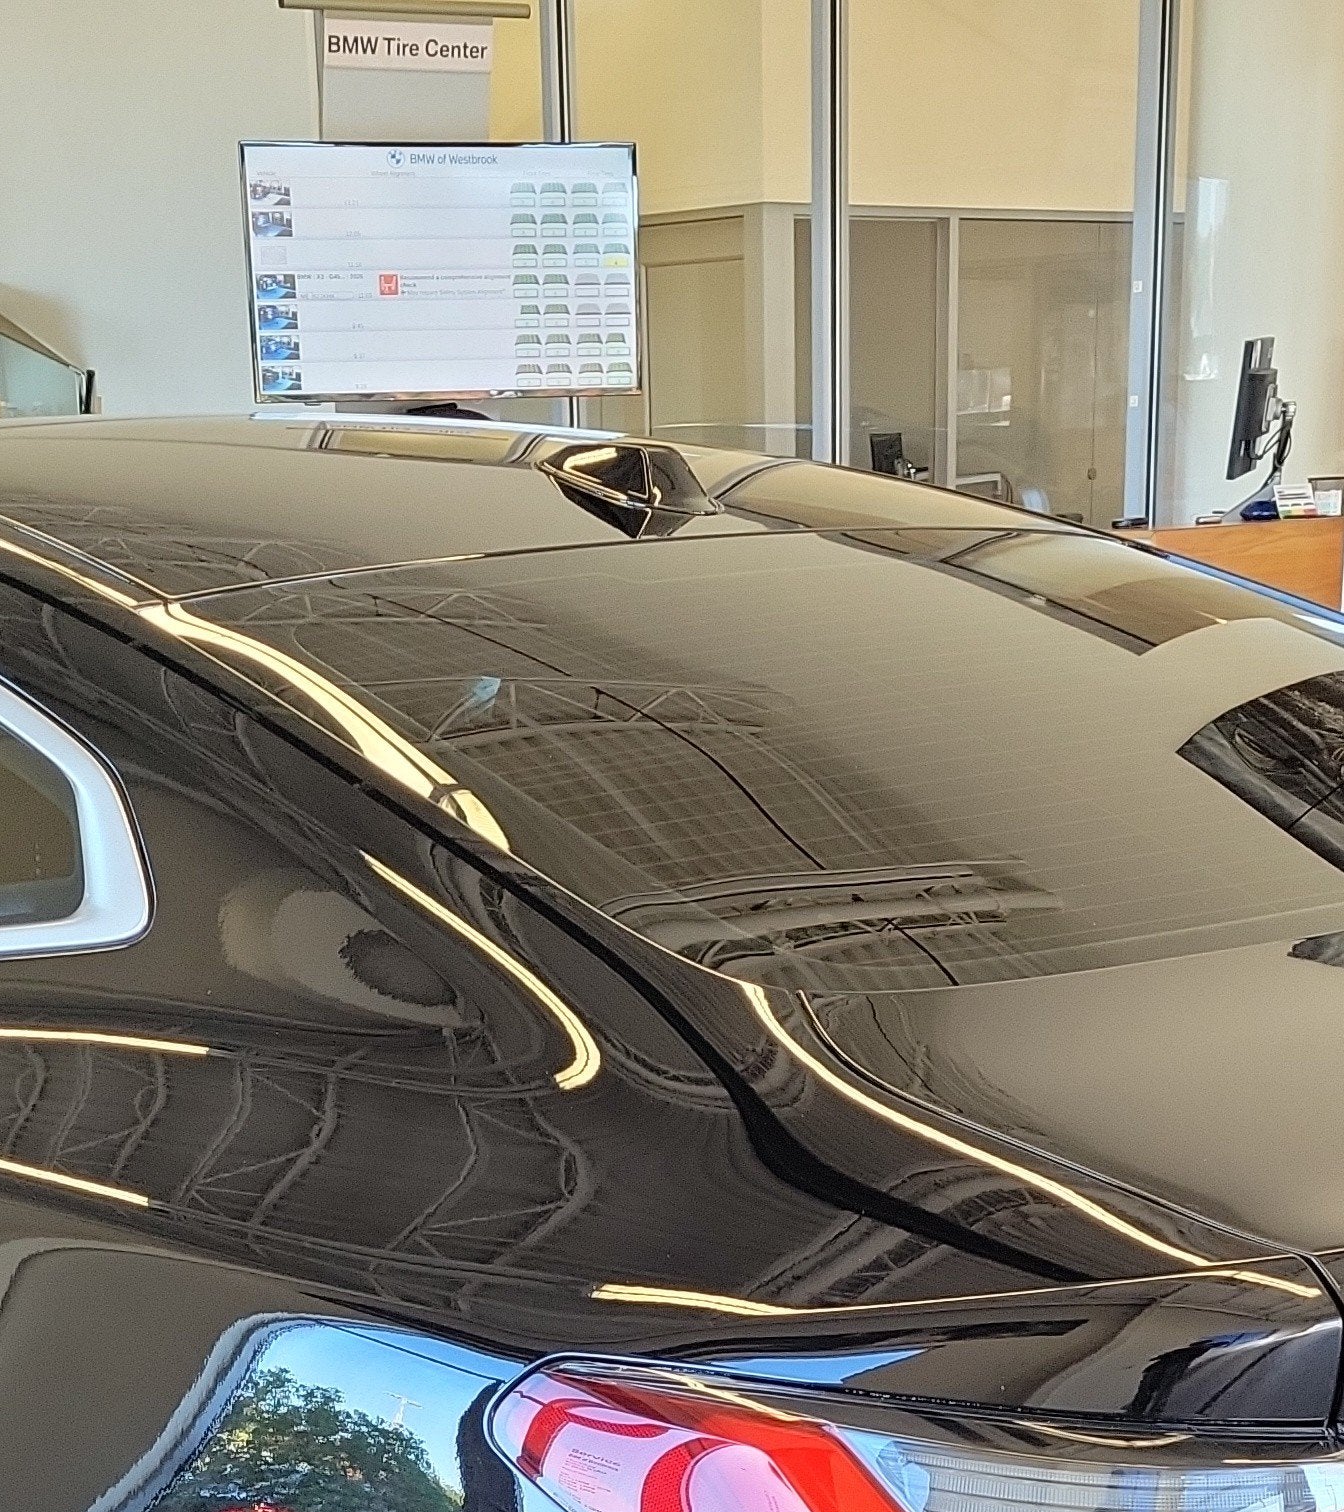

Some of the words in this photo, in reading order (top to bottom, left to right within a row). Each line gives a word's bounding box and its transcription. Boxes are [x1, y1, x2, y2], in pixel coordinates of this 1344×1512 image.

[328, 35, 378, 55] BMW
[383, 37, 419, 57] Tire
[425, 39, 488, 59] Center
[409, 153, 435, 165] BMW
[437, 153, 447, 165] of
[449, 154, 498, 165] Westbrook
